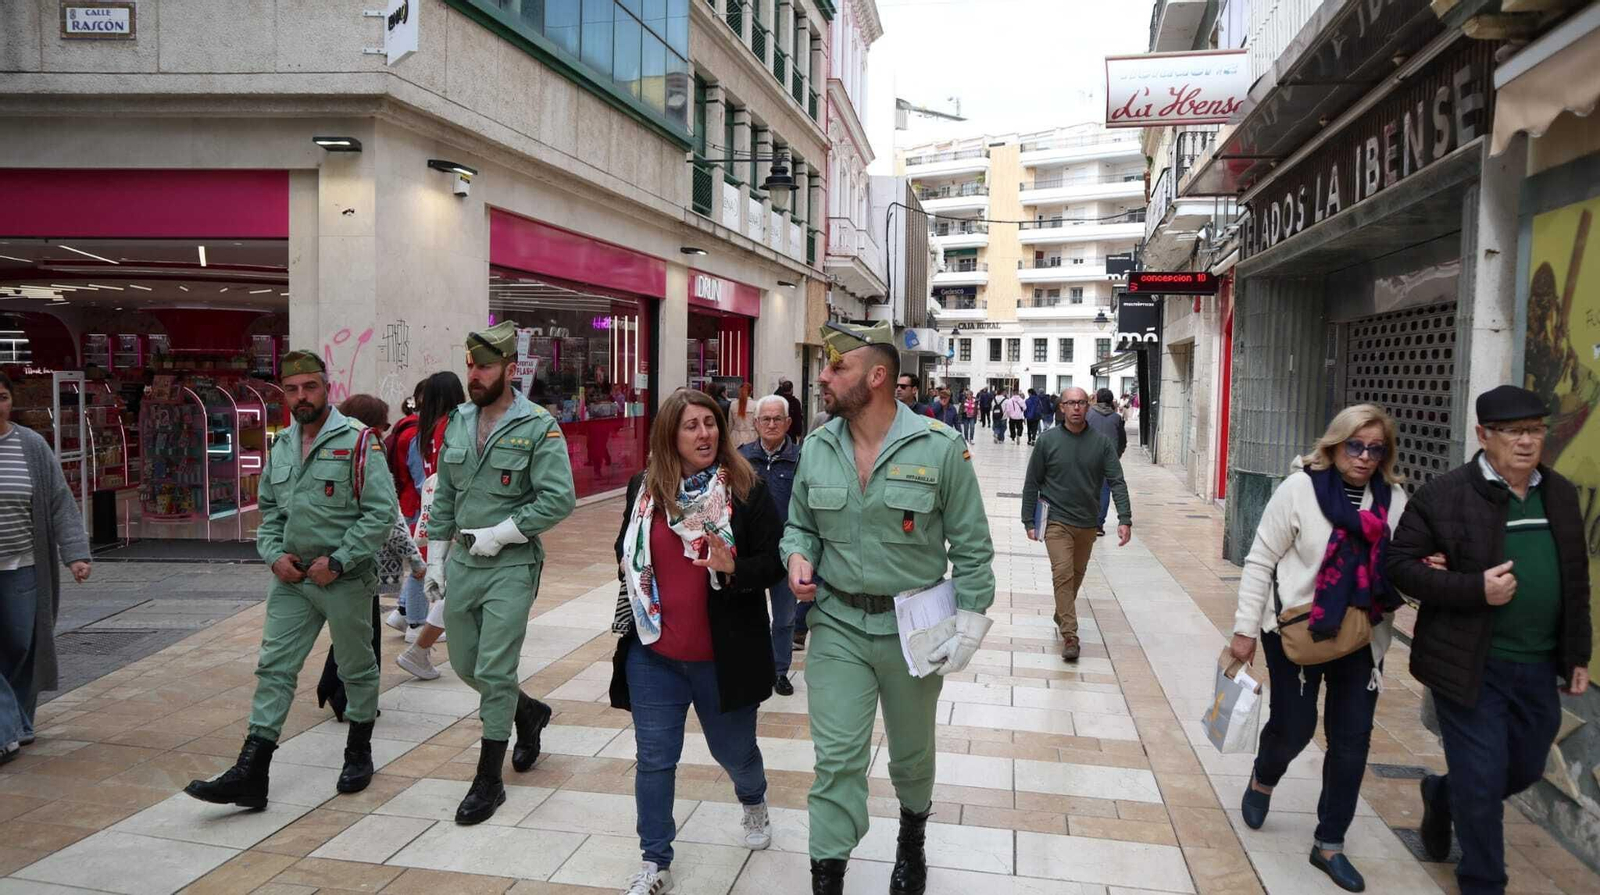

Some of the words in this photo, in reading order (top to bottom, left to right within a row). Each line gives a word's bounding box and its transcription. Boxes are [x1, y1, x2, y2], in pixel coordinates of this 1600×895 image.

[72, 18, 124, 31] RASCÓN
[1111, 86, 1155, 120] La
[1238, 184, 1306, 261] HELADOS
[1315, 162, 1341, 223] LA
[1354, 64, 1484, 204] IBENSE
[1141, 274, 1192, 282] concepcion
[1197, 274, 1206, 282] 10
[977, 322, 1001, 330] RURAL
